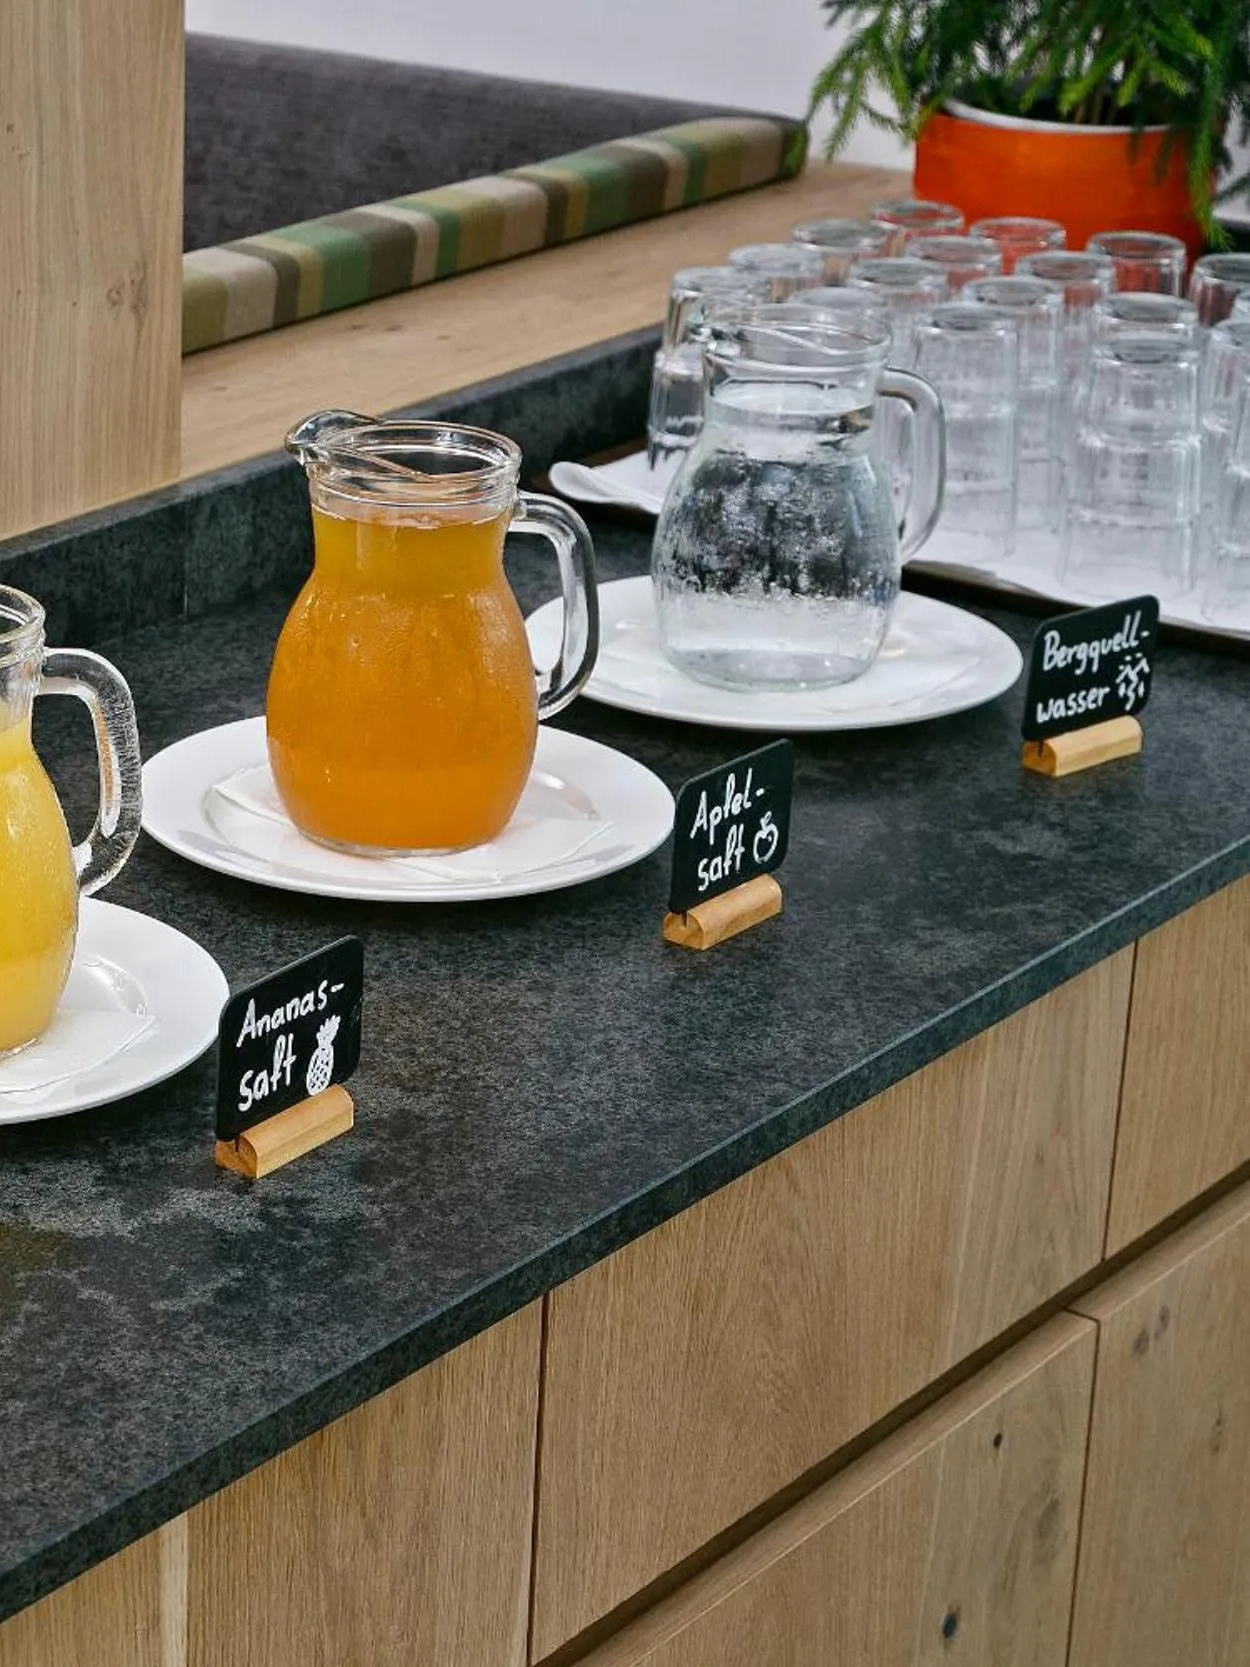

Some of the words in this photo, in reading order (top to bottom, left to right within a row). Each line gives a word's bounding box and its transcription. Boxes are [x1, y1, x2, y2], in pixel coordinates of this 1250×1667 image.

[1043, 610, 1150, 676] Bergquell-
[1036, 686, 1110, 724] wasser
[689, 768, 765, 845] Apfel-
[698, 823, 746, 892] saft
[236, 979, 345, 1048] Ananas-
[237, 1032, 297, 1112] saft
